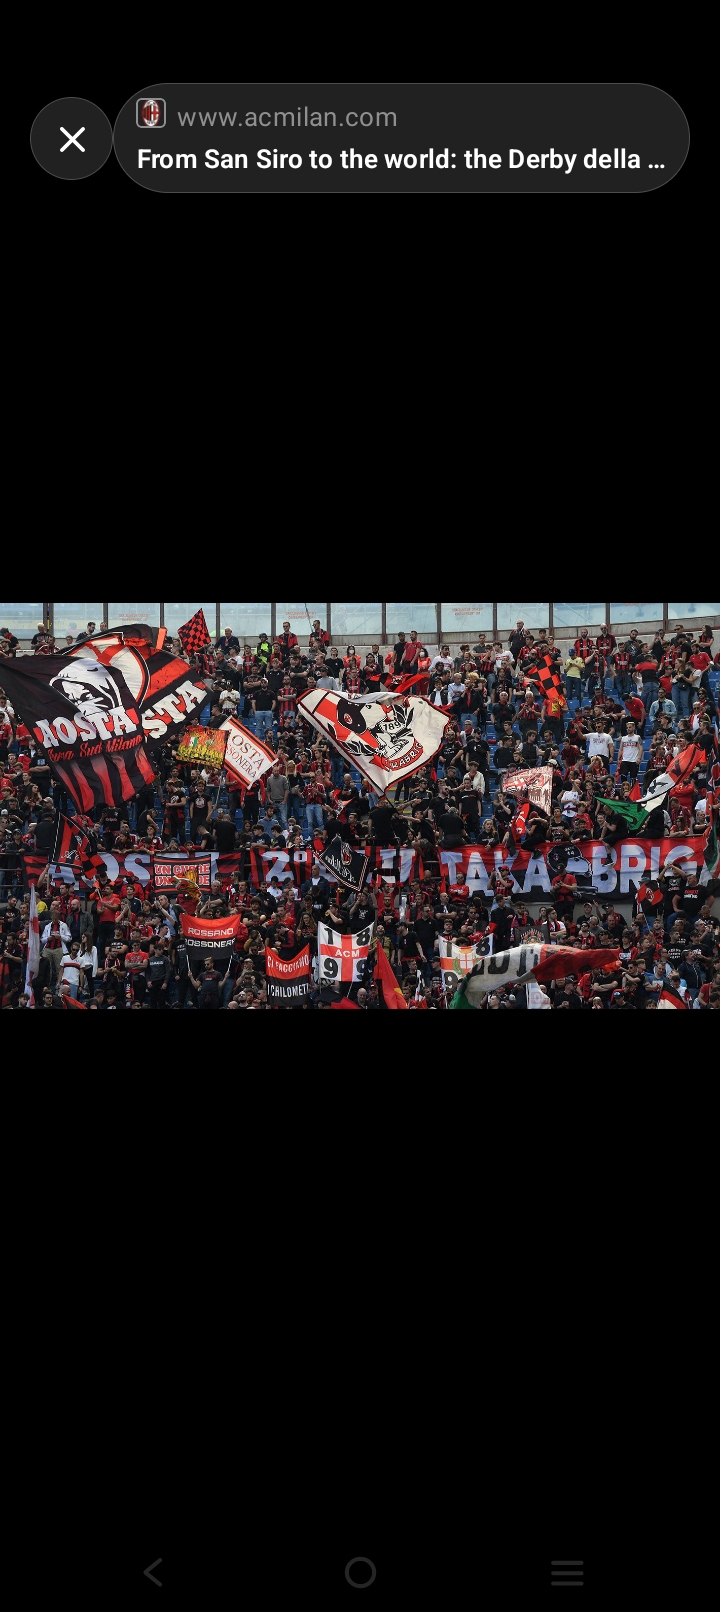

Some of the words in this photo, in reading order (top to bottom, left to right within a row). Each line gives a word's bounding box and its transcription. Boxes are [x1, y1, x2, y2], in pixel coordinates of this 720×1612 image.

[35, 705, 137, 749] AOSTA
[80, 739, 103, 758] Sud
[106, 734, 143, 753] Milano
[154, 864, 172, 875] UN
[440, 851, 552, 898] TAKA
[187, 927, 234, 937] ROSSANO
[323, 927, 334, 946] 1
[356, 927, 371, 947] 8
[267, 955, 275, 968] CI
[275, 954, 310, 973] FACCIAMO
[335, 949, 360, 958] ACM
[323, 957, 339, 979] 9
